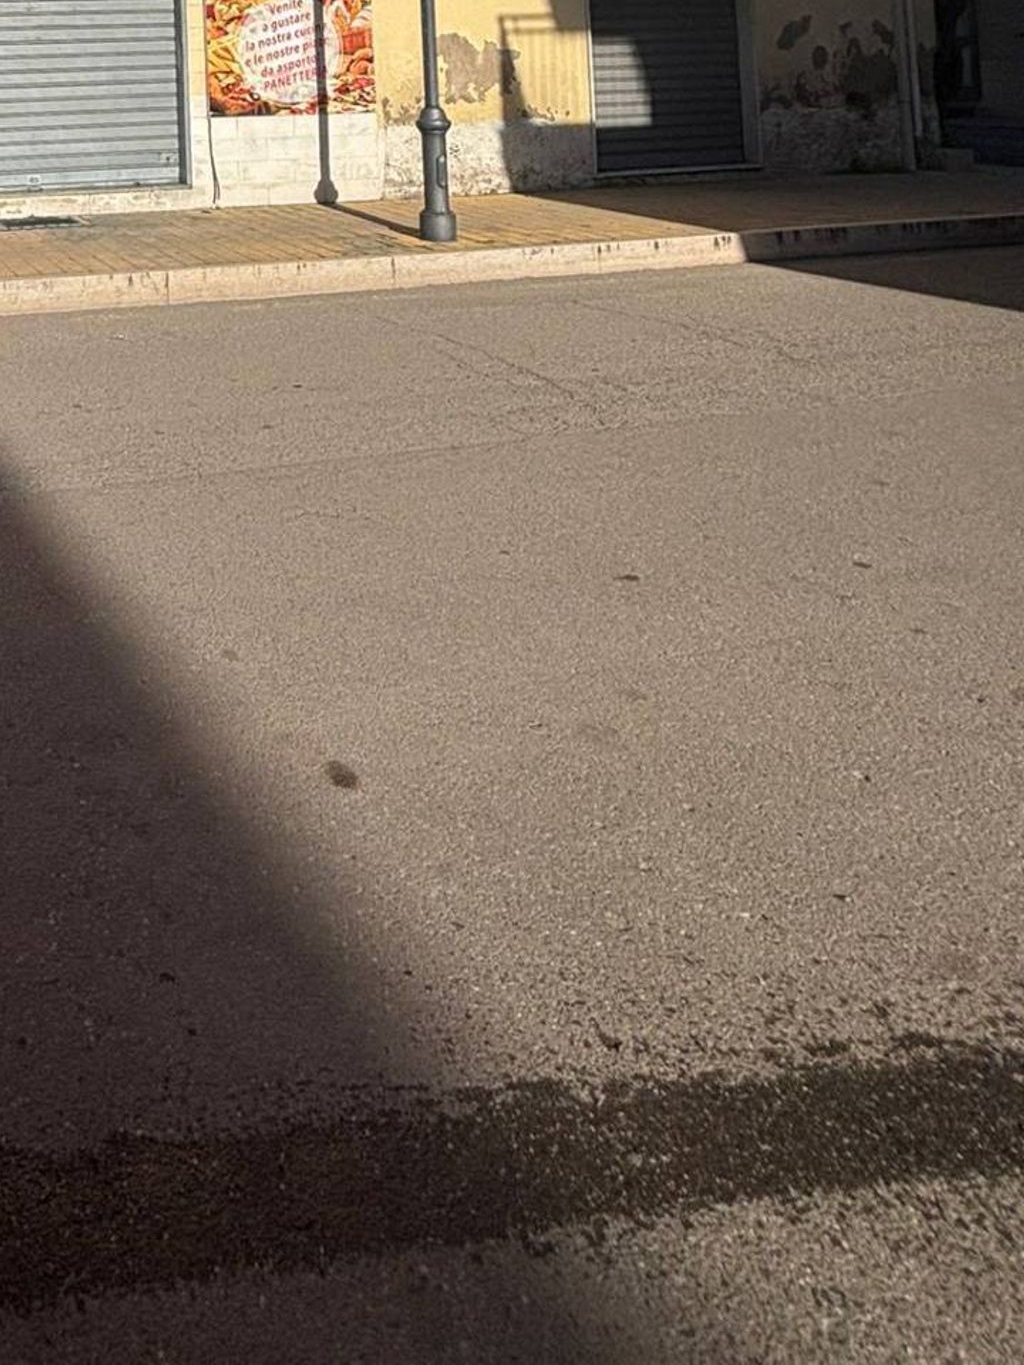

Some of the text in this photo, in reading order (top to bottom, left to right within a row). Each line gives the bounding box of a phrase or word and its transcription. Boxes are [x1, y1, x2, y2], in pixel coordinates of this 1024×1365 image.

[269, 0, 304, 14] Venite
[262, 12, 311, 33] a gustare
[245, 40, 256, 52] la
[258, 32, 292, 49] nostra
[244, 58, 252, 68] e
[253, 53, 264, 66] le
[266, 43, 300, 61] nostre
[261, 54, 320, 78] da asporto
